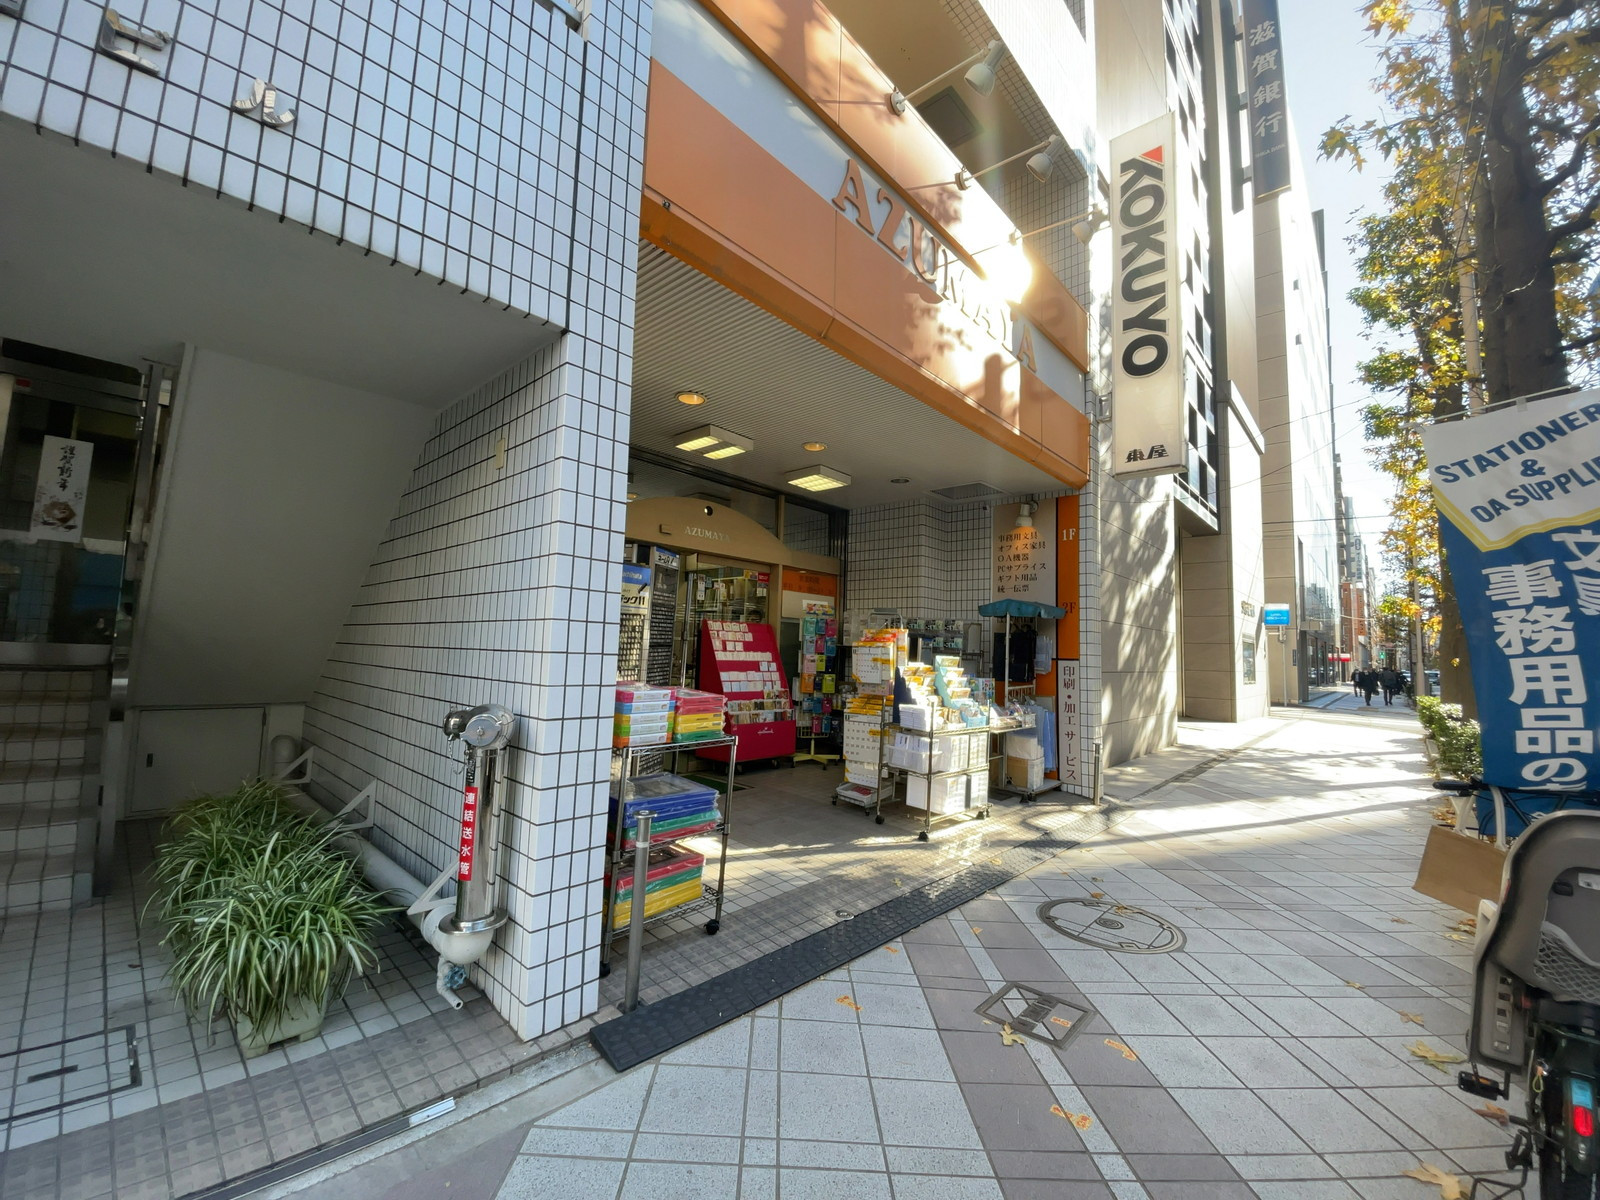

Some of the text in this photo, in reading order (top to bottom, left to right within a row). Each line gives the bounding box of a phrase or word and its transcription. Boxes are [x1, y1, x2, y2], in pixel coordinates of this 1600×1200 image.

[1248, 20, 1283, 137] 滋賀銀行
[1120, 146, 1169, 378] KOKUYO
[1520, 458, 1546, 478] &
[1470, 498, 1511, 523] OA
[684, 526, 731, 542] AZUMAYA
[1062, 528, 1076, 541] 1F
[998, 541, 1046, 553] オフィス家具
[998, 573, 1038, 583] ギフト用品
[1062, 602, 1077, 614] 2F
[1481, 558, 1594, 791] 事務用品の
